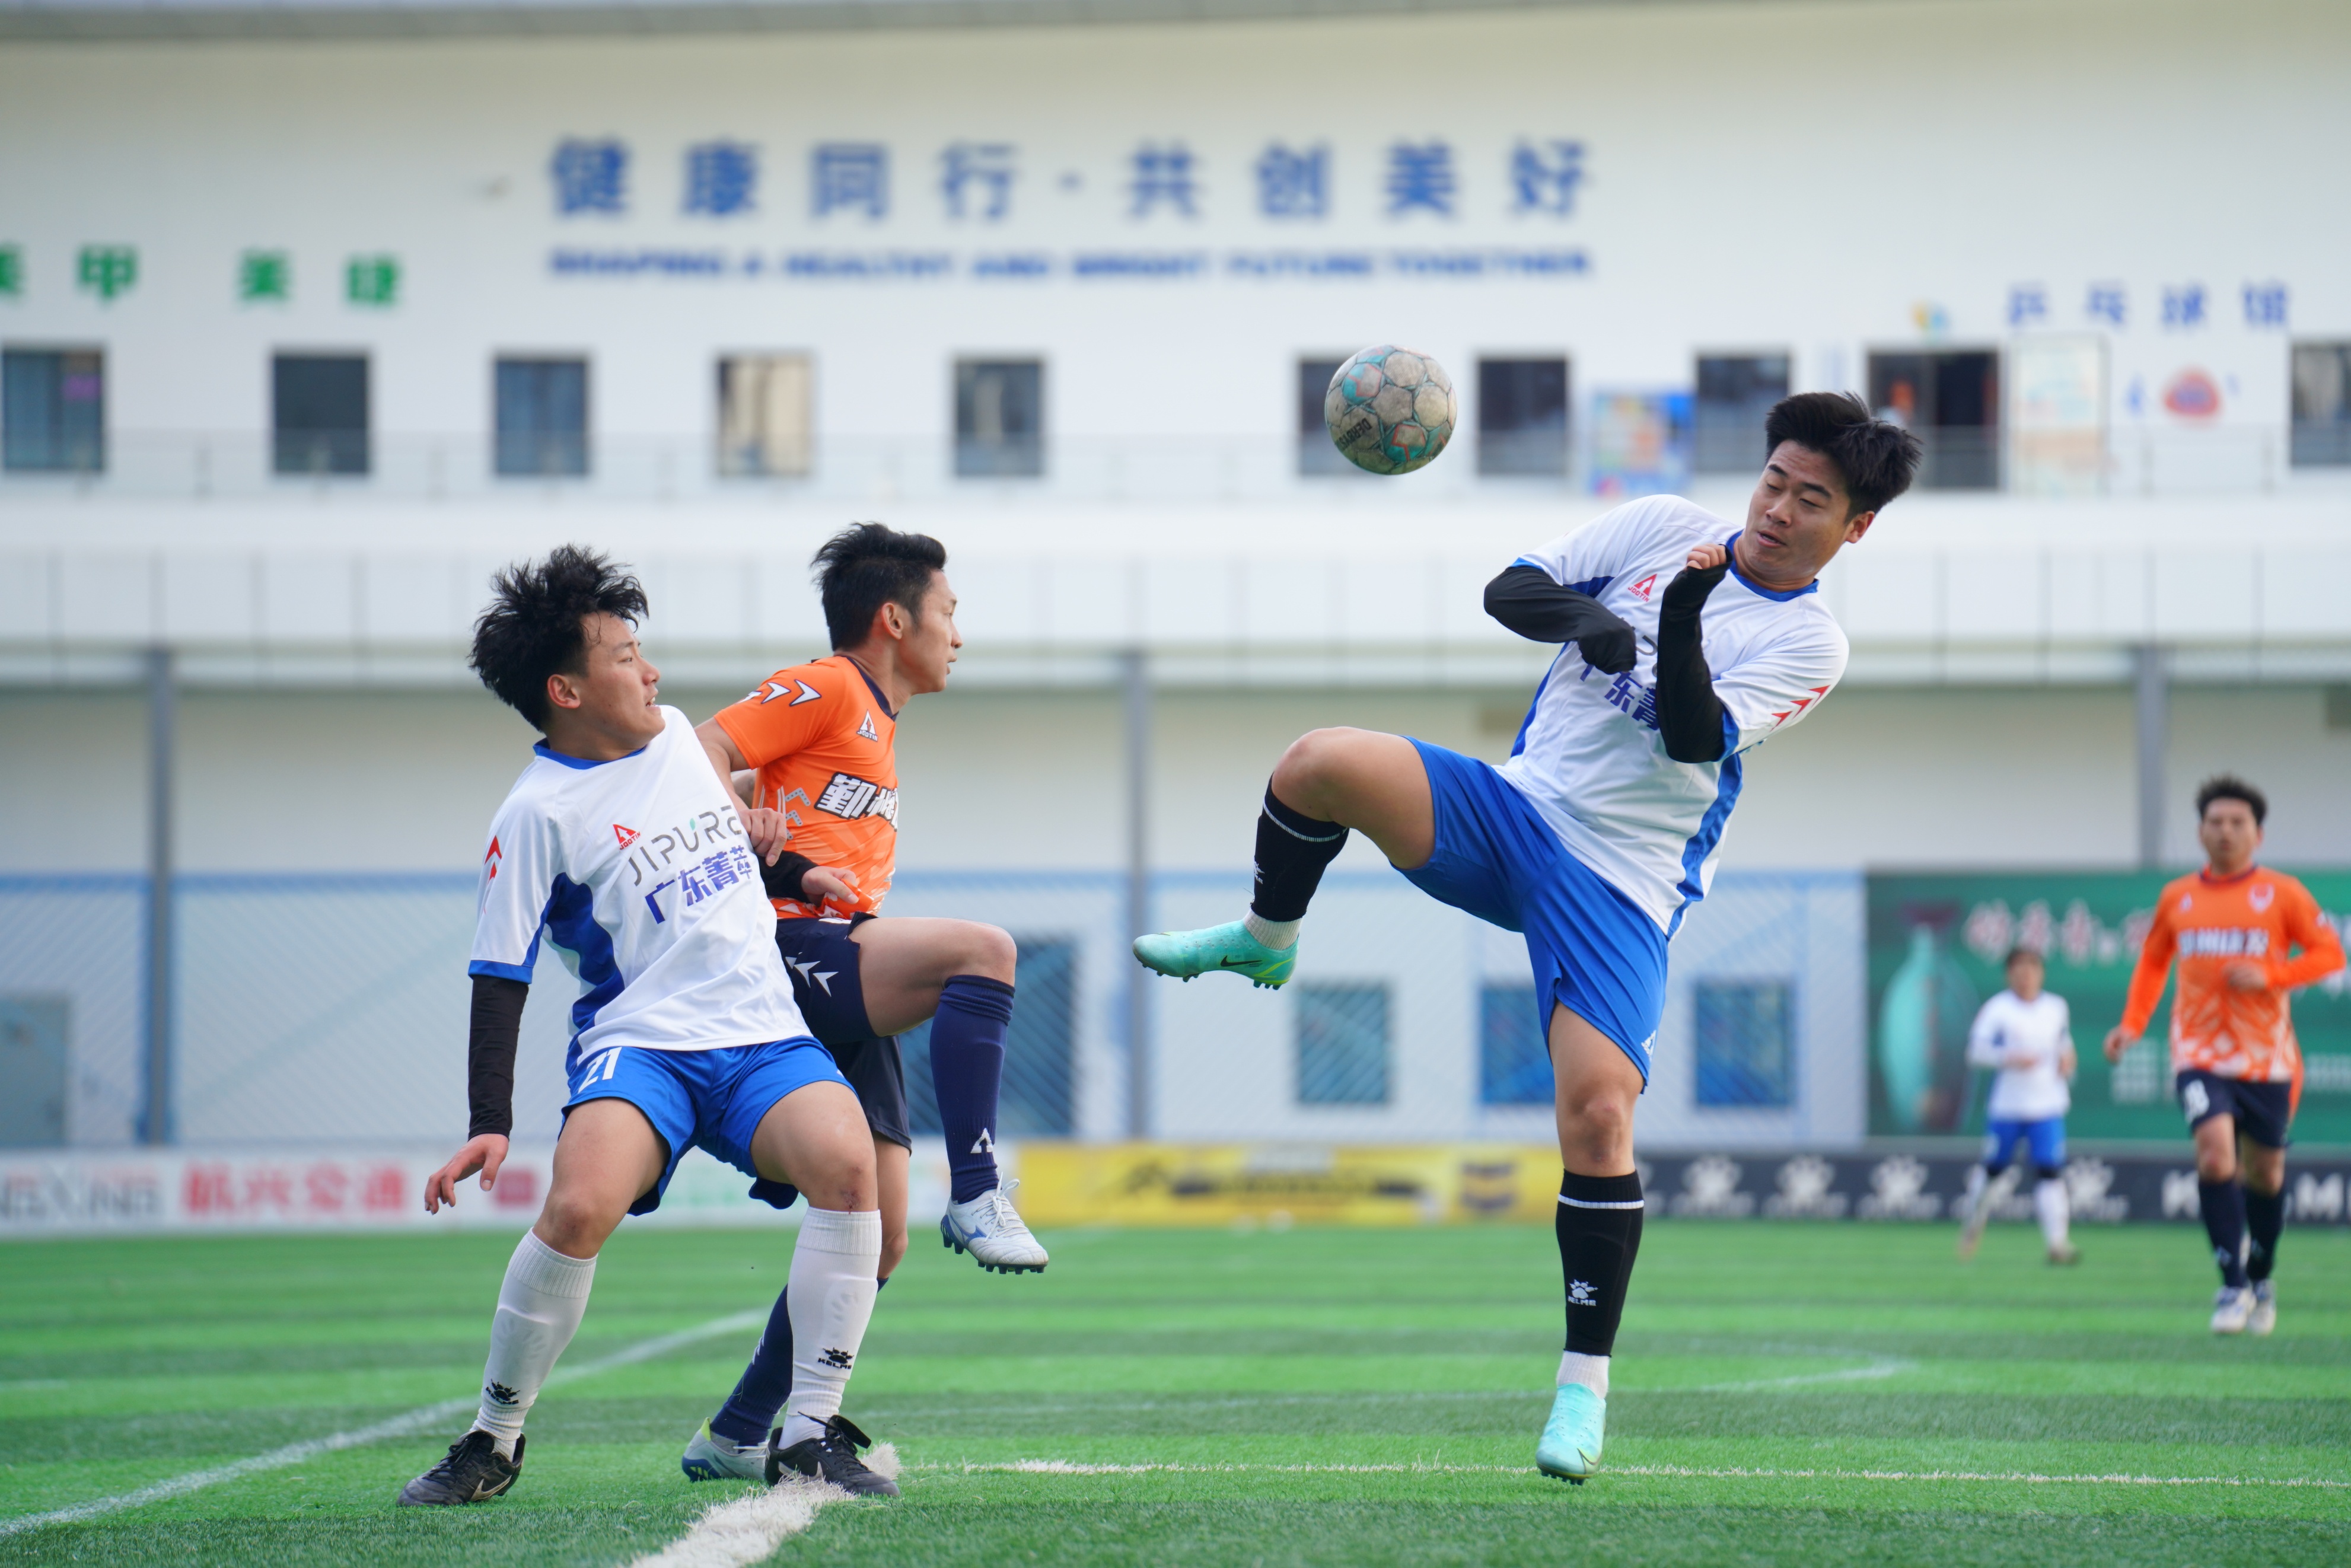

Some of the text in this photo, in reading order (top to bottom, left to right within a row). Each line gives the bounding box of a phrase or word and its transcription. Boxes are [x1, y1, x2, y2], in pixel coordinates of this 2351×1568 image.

[578, 1046, 622, 1094] 21
[1568, 1296, 1597, 1306] KELME
[818, 1357, 852, 1369] KELME
